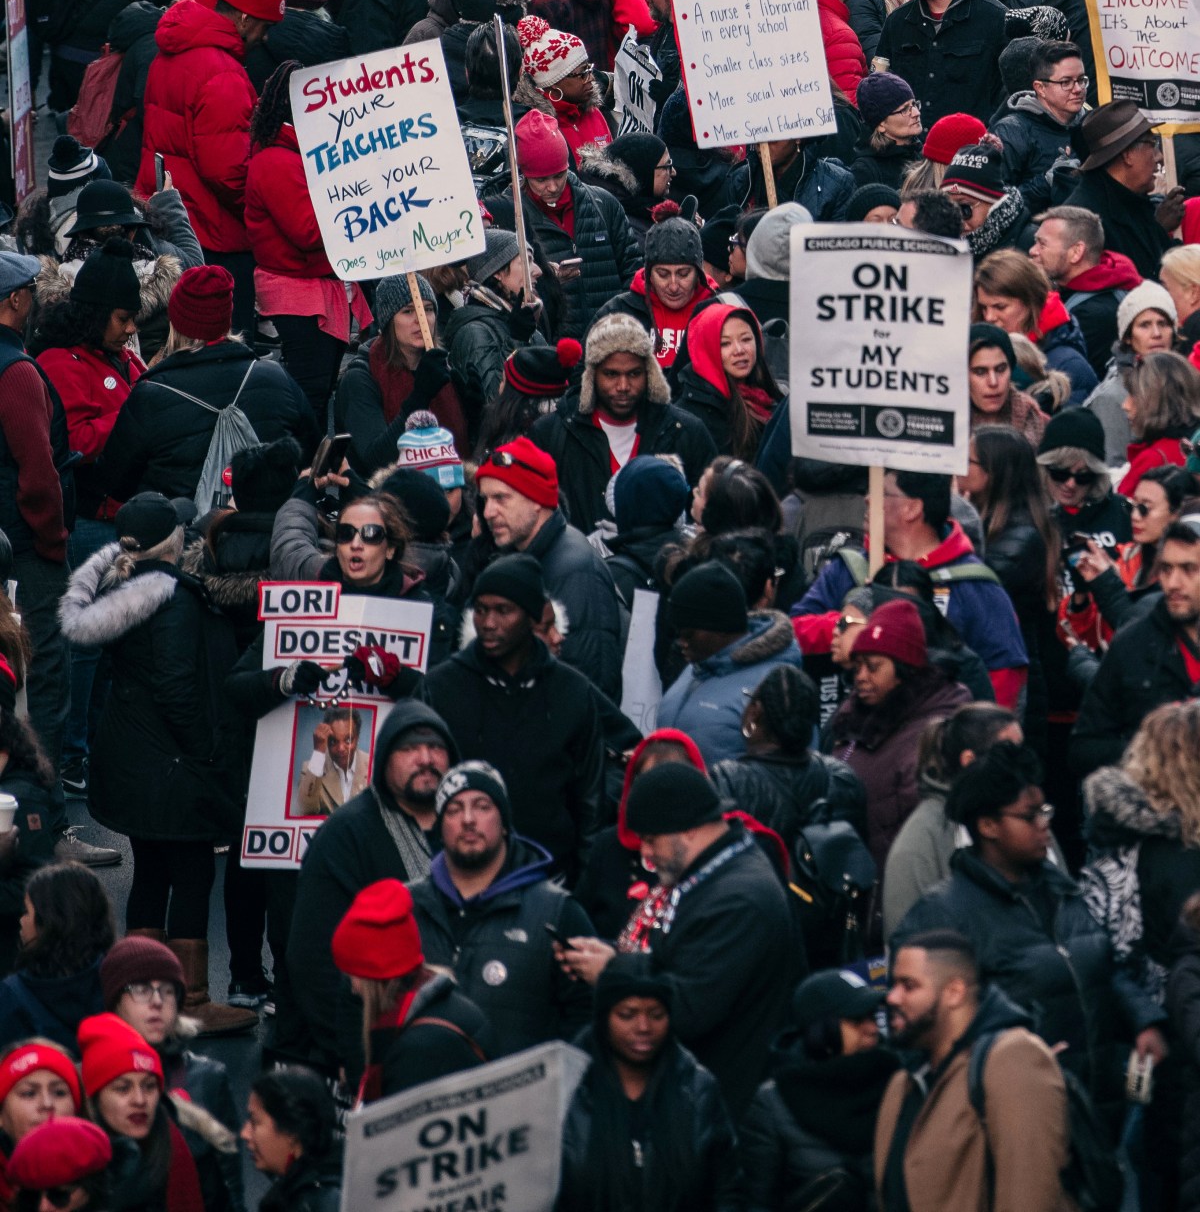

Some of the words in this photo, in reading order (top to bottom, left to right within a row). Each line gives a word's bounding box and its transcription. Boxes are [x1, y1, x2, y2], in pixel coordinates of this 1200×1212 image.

[711, 7, 739, 22] nurse
[1145, 14, 1188, 29] About
[720, 23, 751, 46] every
[757, 17, 788, 34] school
[702, 55, 741, 78] Smaller
[749, 50, 773, 69] class
[779, 50, 809, 64] sizes
[303, 52, 439, 113] Students,
[709, 90, 735, 110] More
[746, 82, 775, 103] social
[780, 80, 820, 98] workers
[714, 124, 739, 141] More
[778, 112, 814, 132] Education
[306, 112, 438, 176] TEACHERS
[328, 178, 372, 203] HAVE
[334, 185, 454, 242] BACK...
[412, 210, 474, 254] Mayor?
[807, 239, 861, 250] CHICAGO
[862, 240, 901, 251] PUBLIC
[853, 263, 908, 291] ON
[816, 294, 945, 326] STRIKE
[860, 345, 903, 366] MY
[810, 368, 950, 396] STUDENTS
[405, 445, 456, 462] CHICAG
[264, 589, 334, 614] LORI
[279, 629, 418, 660] DOESN'T
[247, 830, 286, 853] DO
[418, 1108, 487, 1150] ON
[376, 1124, 530, 1197] STRIKE
